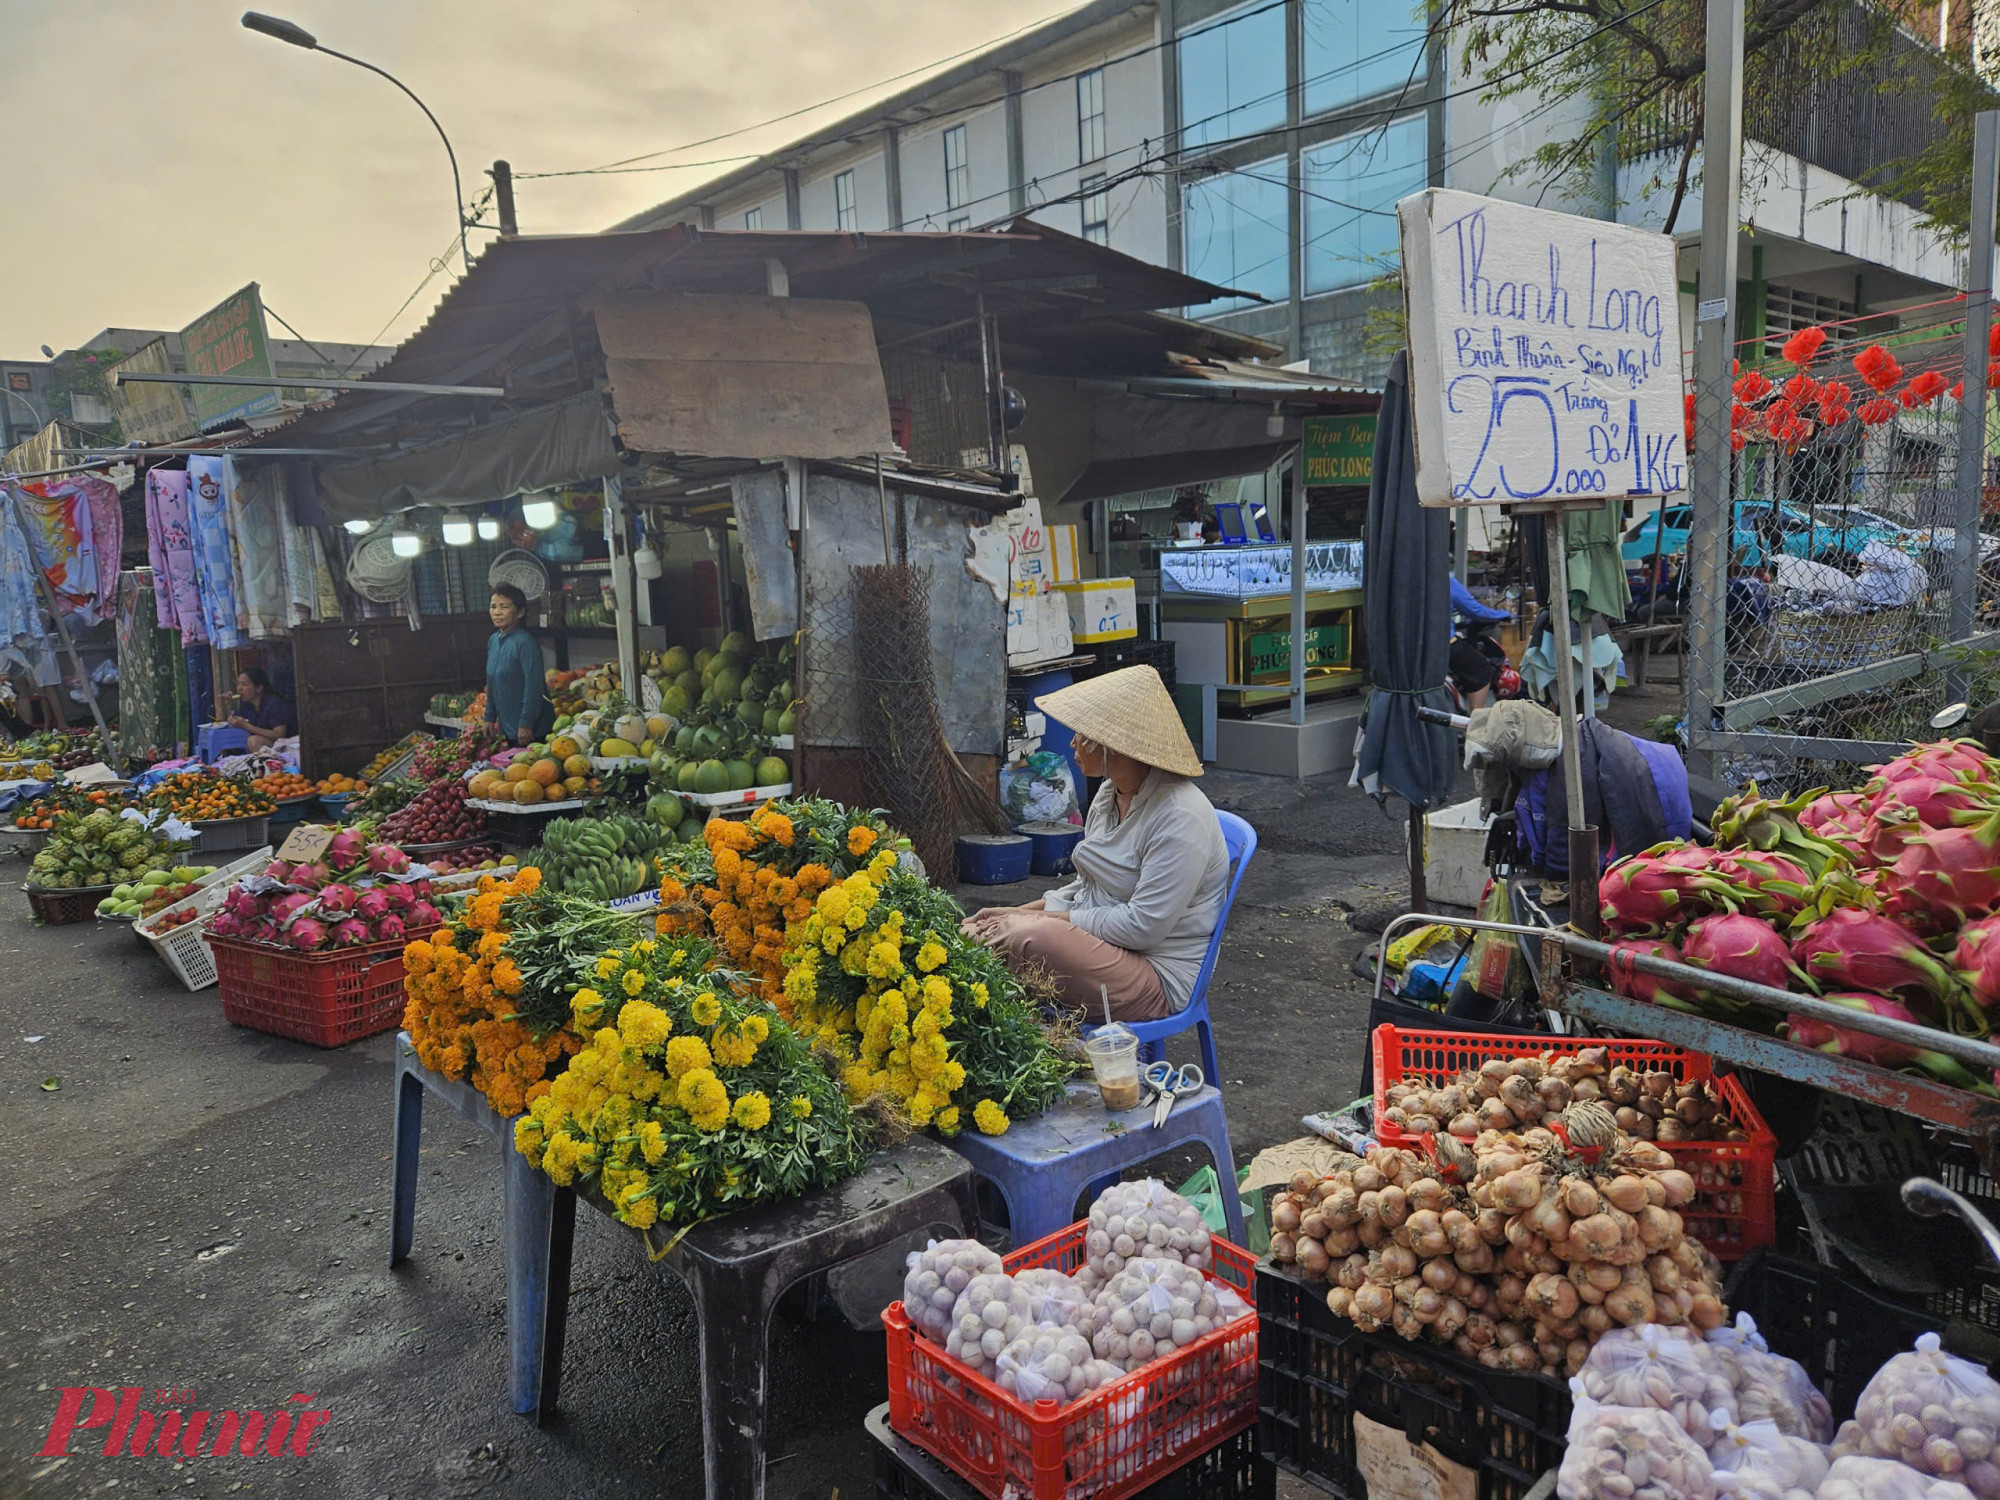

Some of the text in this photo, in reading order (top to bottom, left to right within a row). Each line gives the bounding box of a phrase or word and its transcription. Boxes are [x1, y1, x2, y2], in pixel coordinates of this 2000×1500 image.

[1436, 206, 1665, 367] Thanh Long
[1454, 325, 1509, 368] Bình
[1308, 451, 1373, 478] PHÚC LONG
[1304, 644, 1337, 664] ONG
